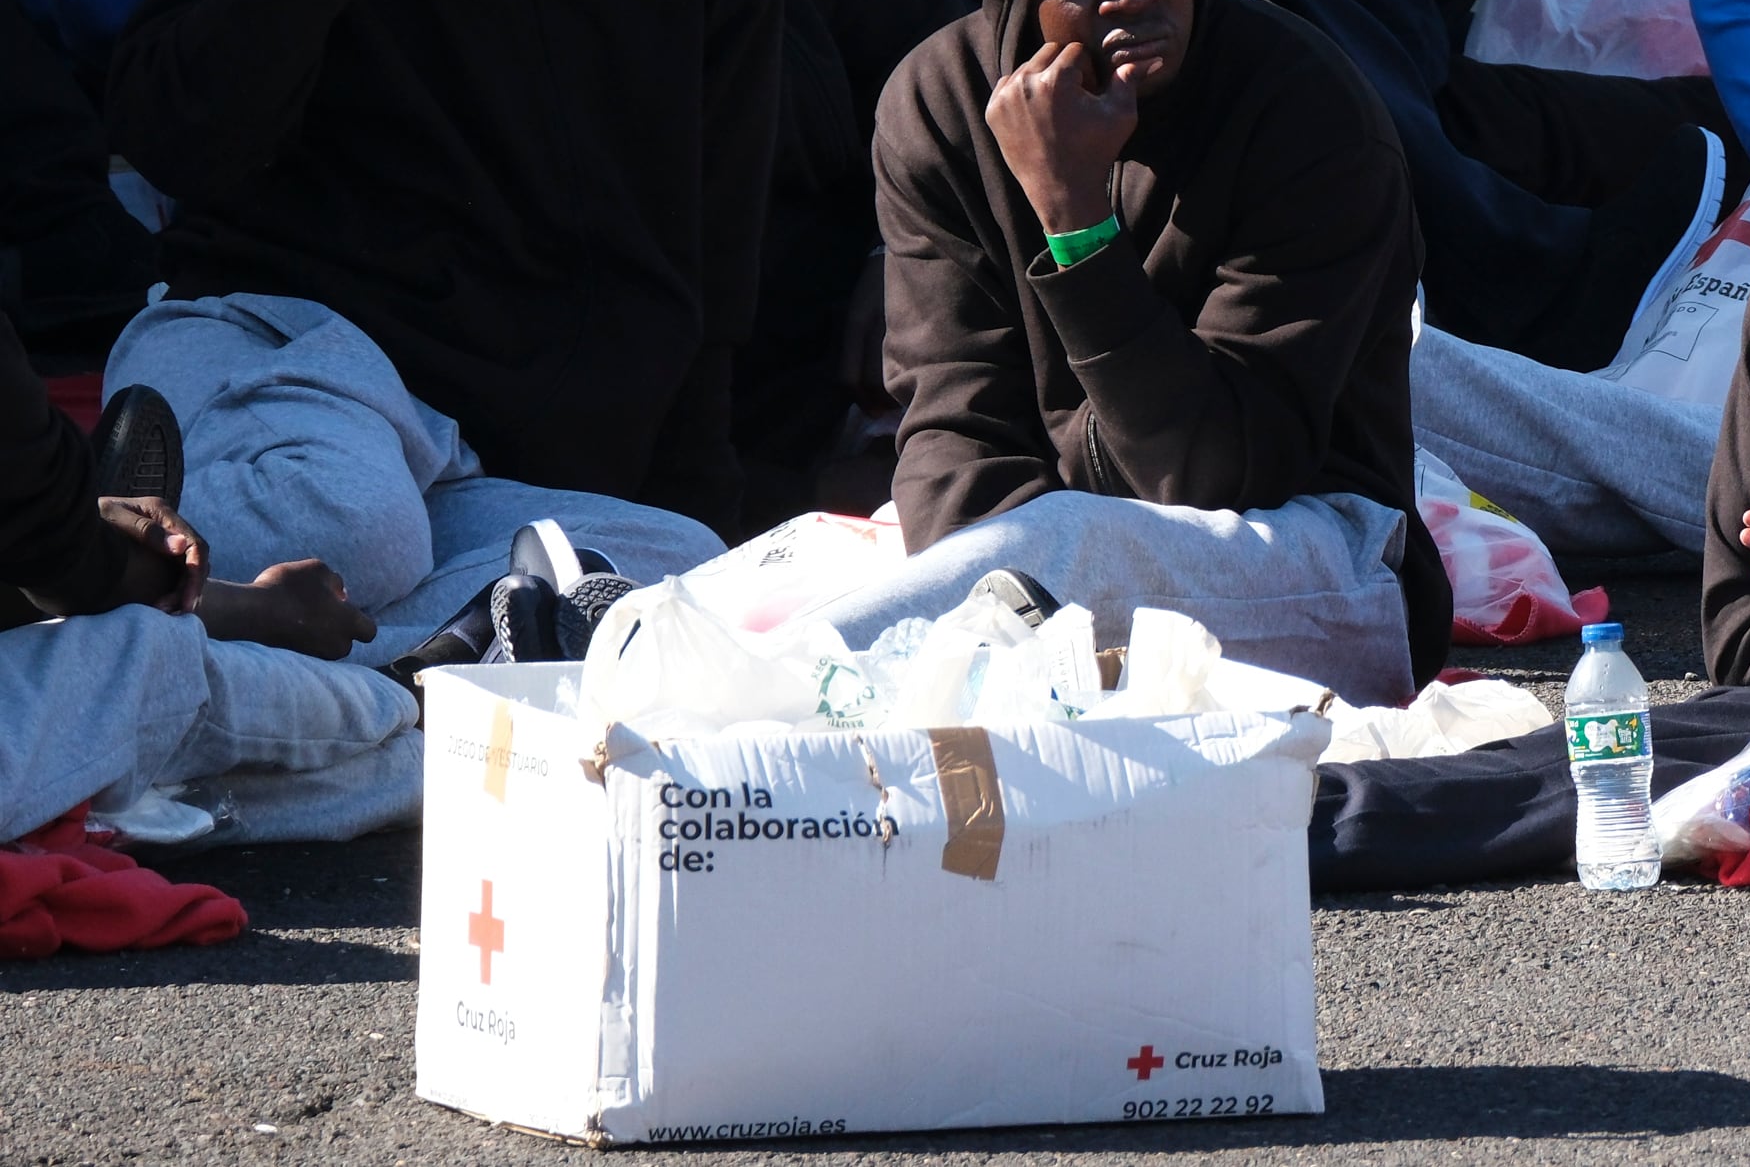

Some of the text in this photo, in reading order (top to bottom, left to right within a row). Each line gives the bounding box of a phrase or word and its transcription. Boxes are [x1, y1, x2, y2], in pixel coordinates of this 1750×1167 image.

[659, 782, 773, 809] Con la
[659, 810, 900, 840] colaboración
[659, 844, 715, 873] de:
[456, 1000, 516, 1046] Cruz Roja
[1175, 1045, 1283, 1070] Cruz Roja
[1123, 1094, 1274, 1120] 902 22 22 92
[648, 1116, 847, 1141] www.cruzroja.es
